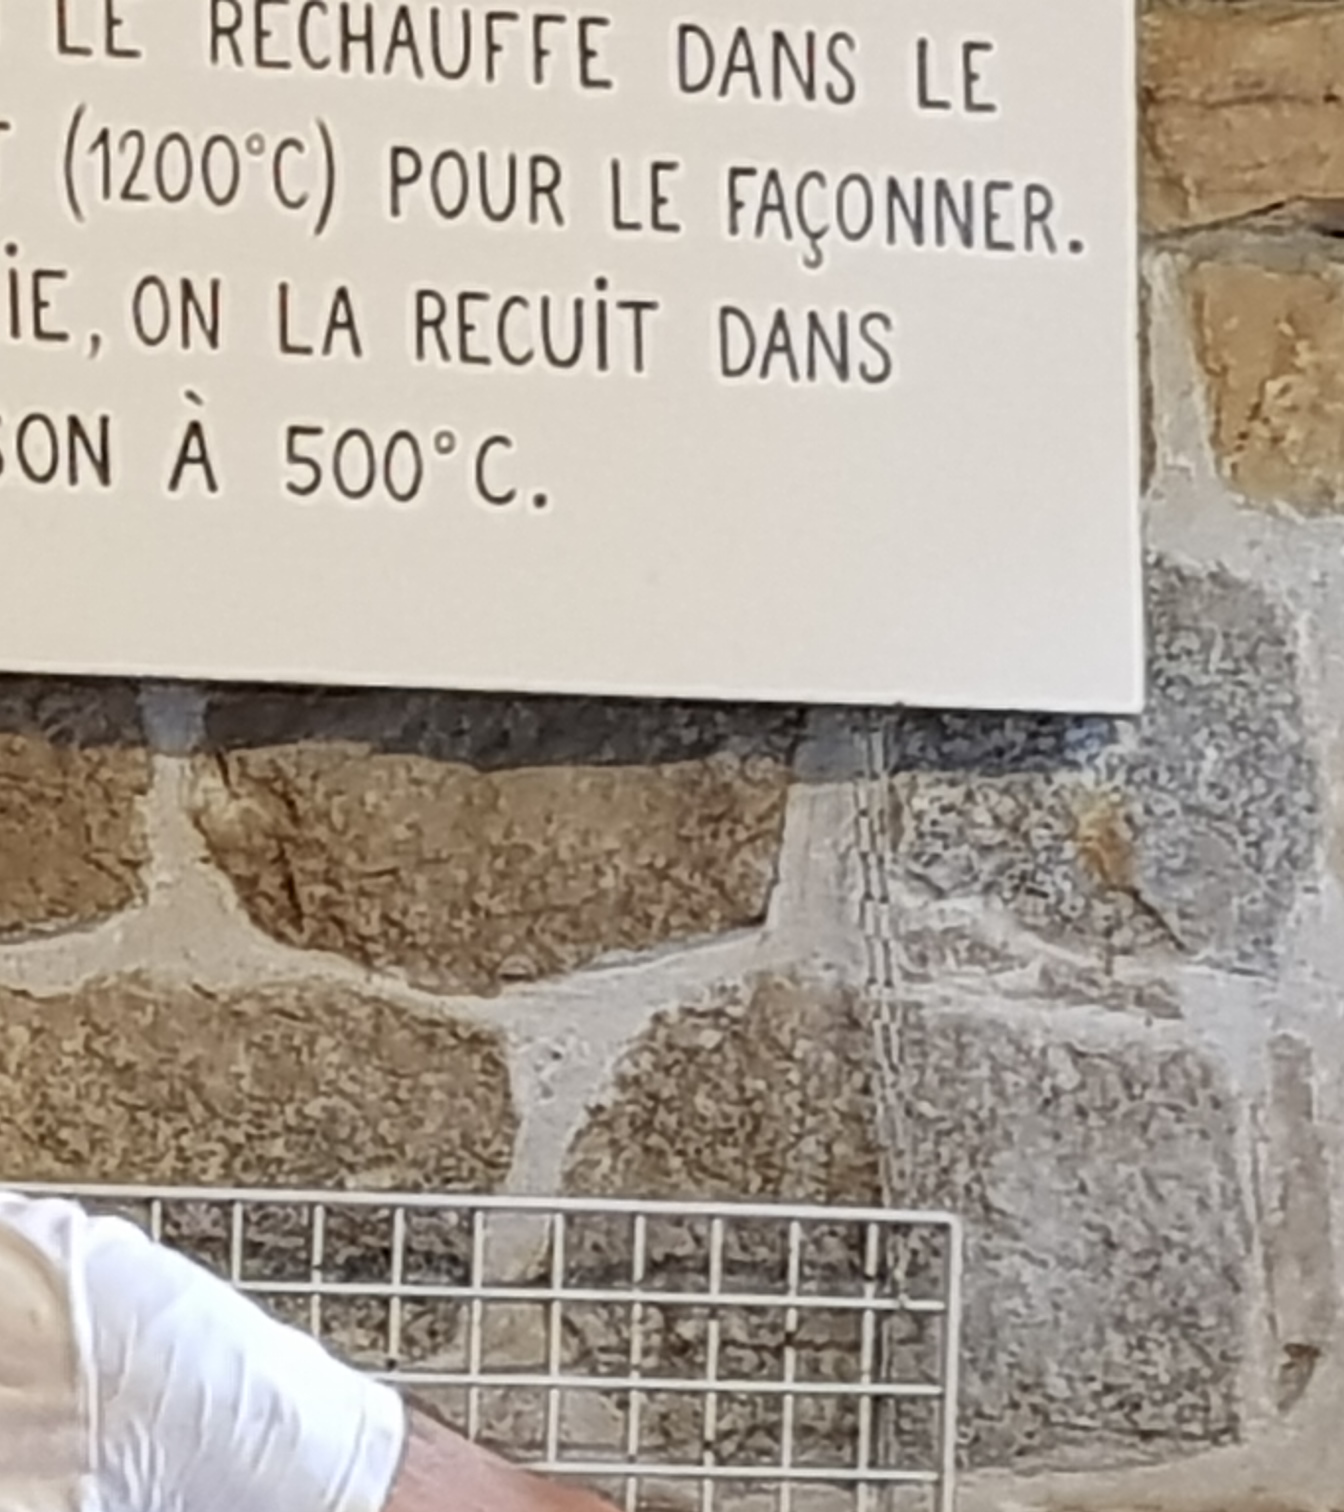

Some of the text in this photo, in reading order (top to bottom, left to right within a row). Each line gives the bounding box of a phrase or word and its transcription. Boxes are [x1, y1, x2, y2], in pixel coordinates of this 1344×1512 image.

[55, 0, 143, 60] LE
[676, 22, 857, 106] DANS
[915, 36, 998, 114] LE
[389, 144, 566, 228] POUR
[609, 157, 682, 234] LE
[726, 165, 1085, 270] FAÇONNER.
[131, 273, 222, 351] ON
[277, 280, 364, 359] LA
[717, 304, 893, 386] DANS
[166, 389, 220, 495] À
